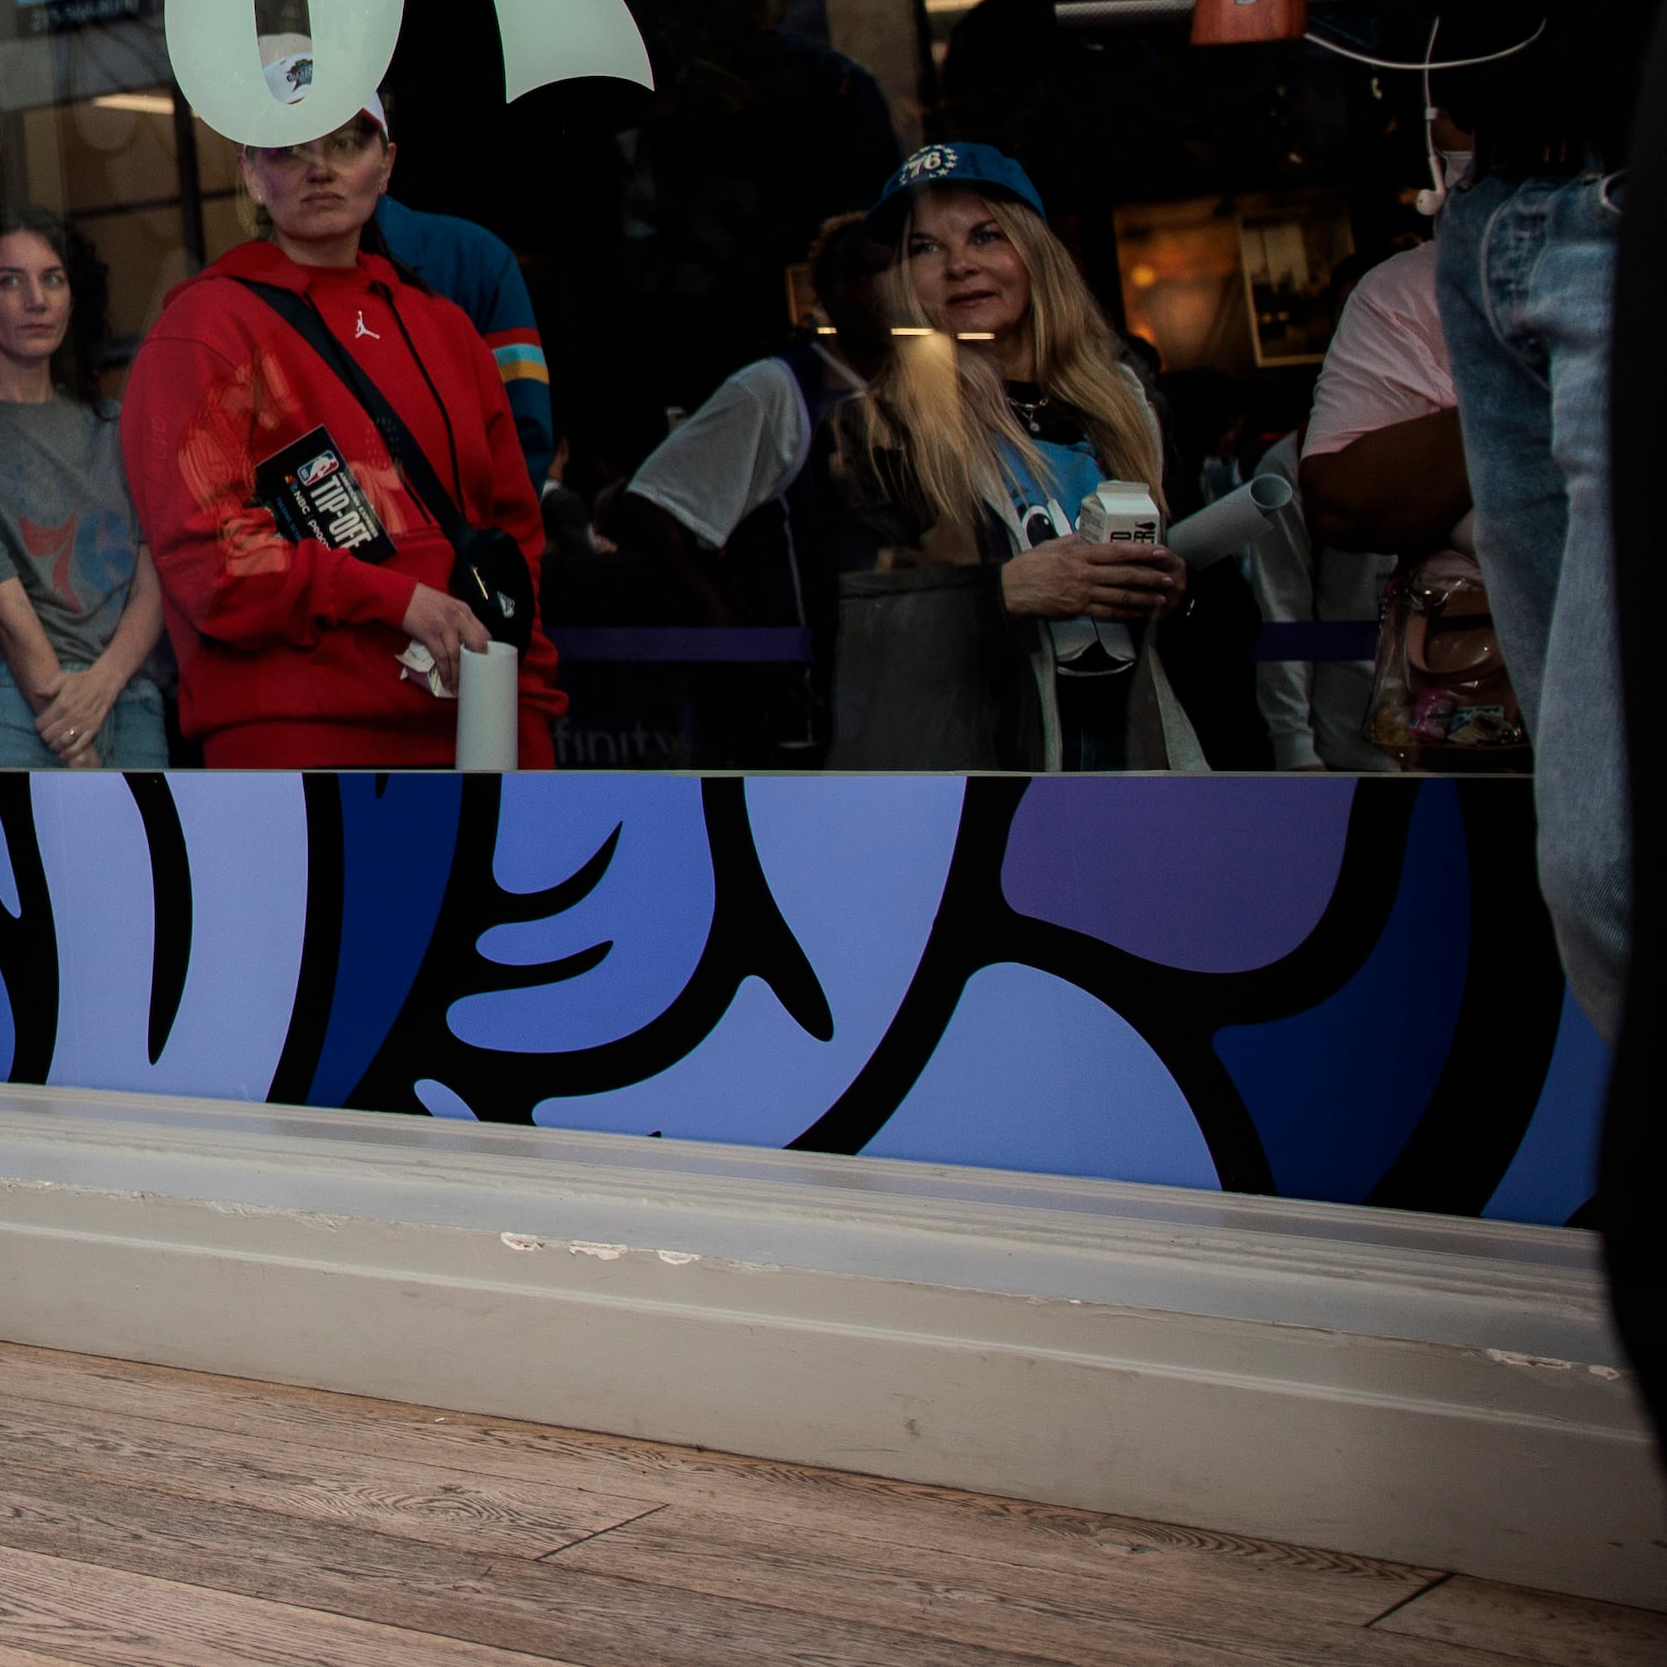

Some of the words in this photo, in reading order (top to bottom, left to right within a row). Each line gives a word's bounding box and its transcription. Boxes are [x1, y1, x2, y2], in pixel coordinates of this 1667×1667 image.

[906, 150, 943, 179] 76
[293, 490, 311, 515] NBC
[309, 474, 373, 549] TIP-OFF
